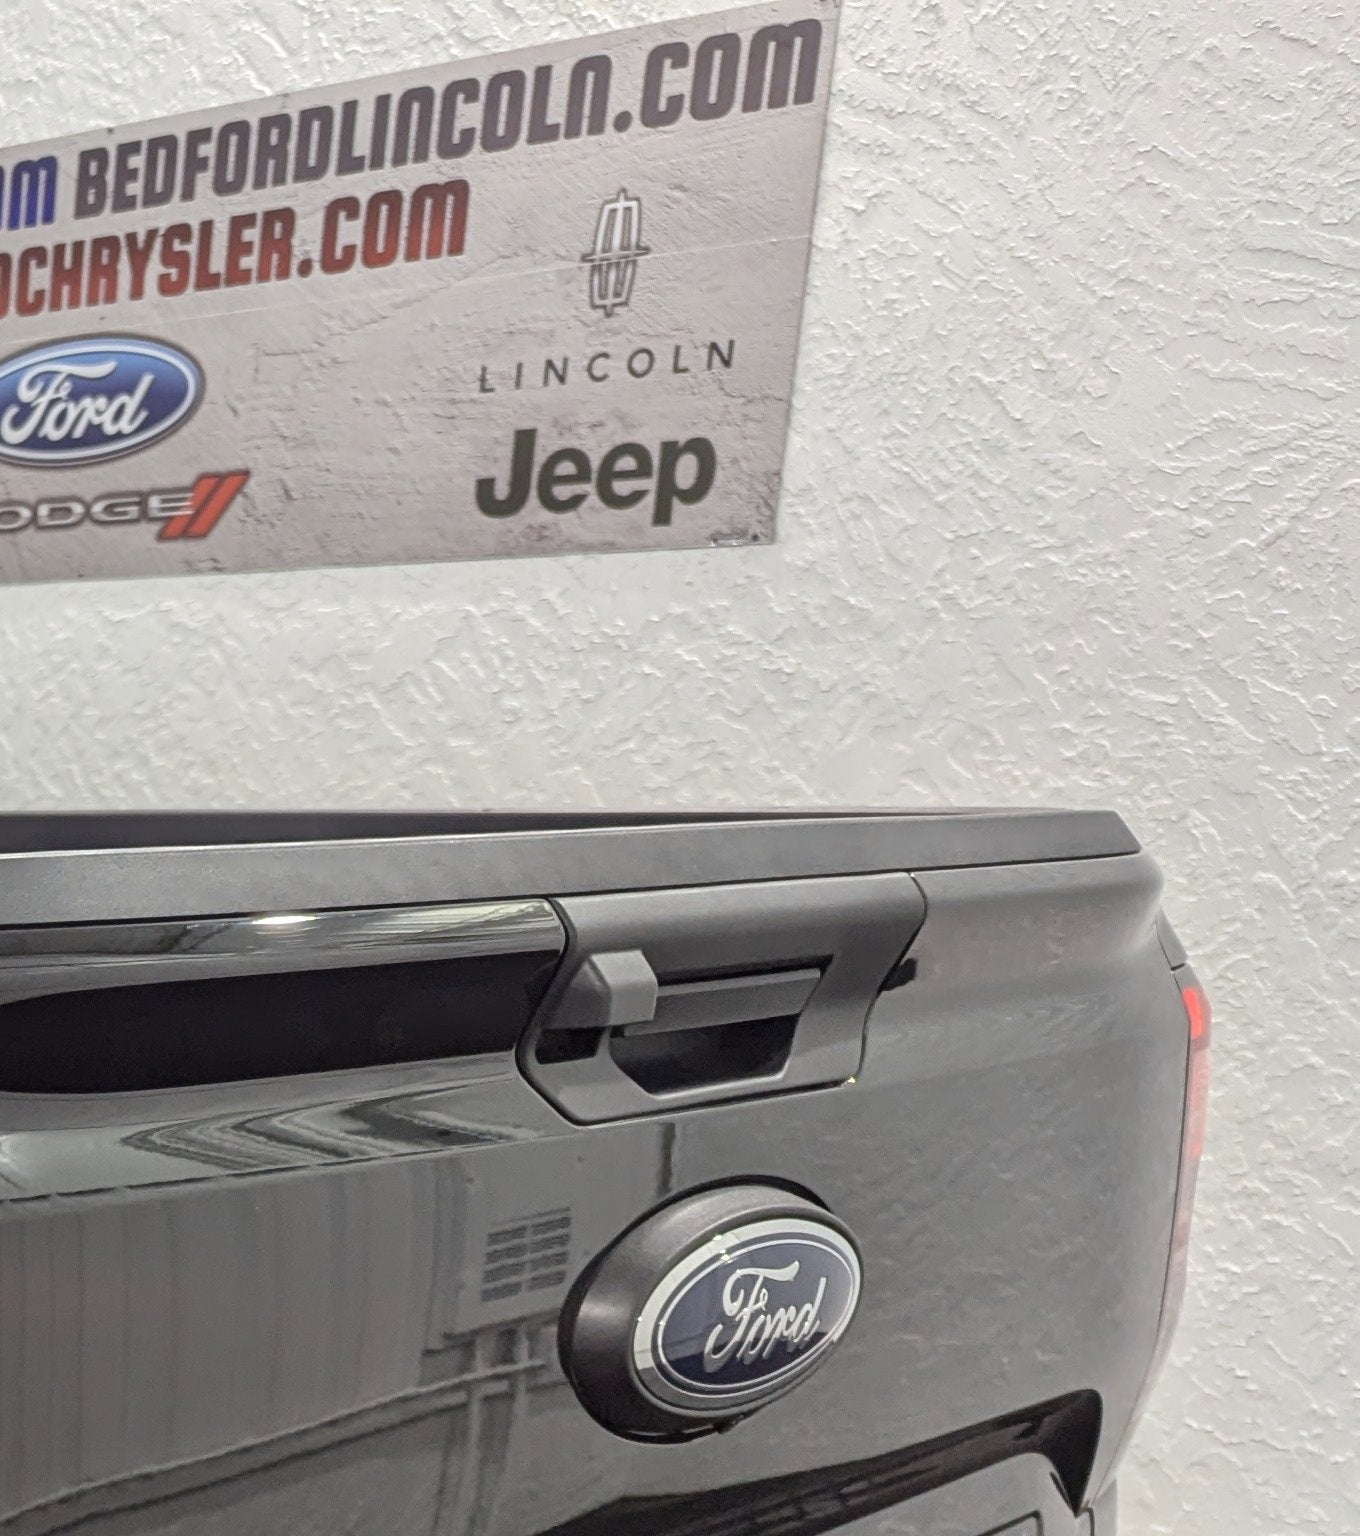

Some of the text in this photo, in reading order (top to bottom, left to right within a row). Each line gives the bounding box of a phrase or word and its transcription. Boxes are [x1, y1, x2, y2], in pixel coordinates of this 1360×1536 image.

[73, 18, 823, 220] BEDFORDLINCOLN.COM
[0, 360, 155, 444] Ford
[479, 339, 735, 393] LINCOLN
[475, 428, 716, 526] Jeep
[703, 1261, 827, 1373] Ford
